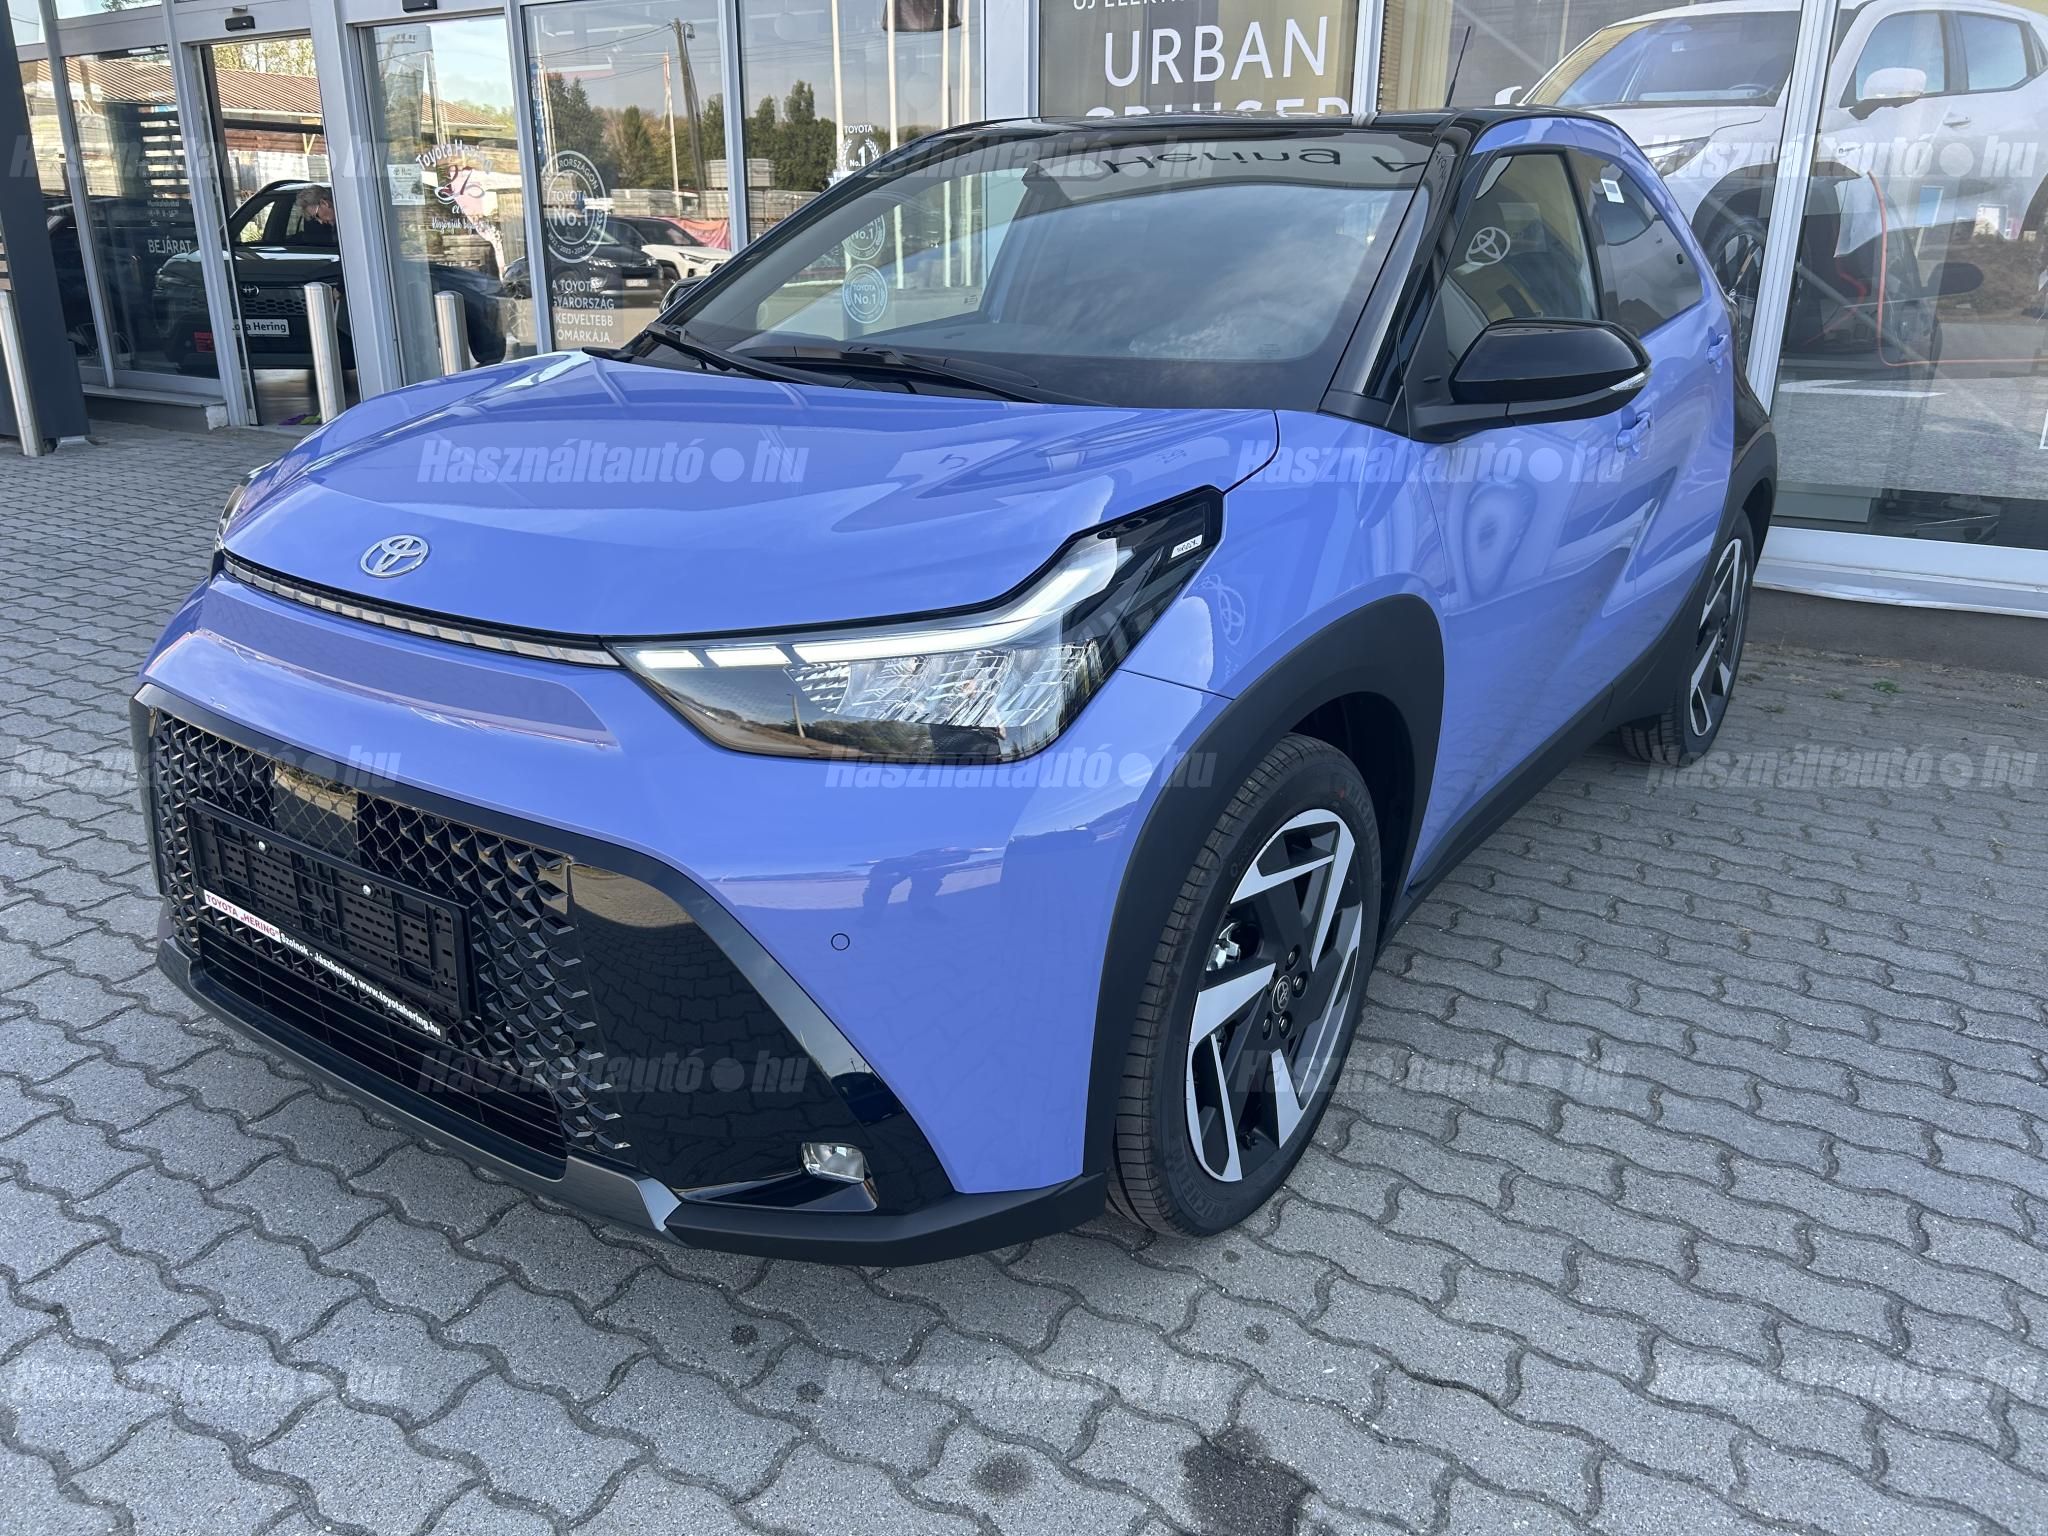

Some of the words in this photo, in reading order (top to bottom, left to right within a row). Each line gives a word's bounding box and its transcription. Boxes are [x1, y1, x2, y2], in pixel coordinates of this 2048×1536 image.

[1105, 16, 1328, 87] URBAN
[844, 125, 873, 134] TOYOTA
[551, 190, 588, 202] TOYOTA
[554, 207, 589, 227] No.1
[148, 235, 192, 254] BEJÁRAT
[853, 293, 876, 305] No.1
[253, 321, 287, 333] Hering
[206, 893, 238, 918] TOYOTA
[281, 932, 309, 956] Szolnok
[358, 979, 441, 1037] www.toyotahering.hu
